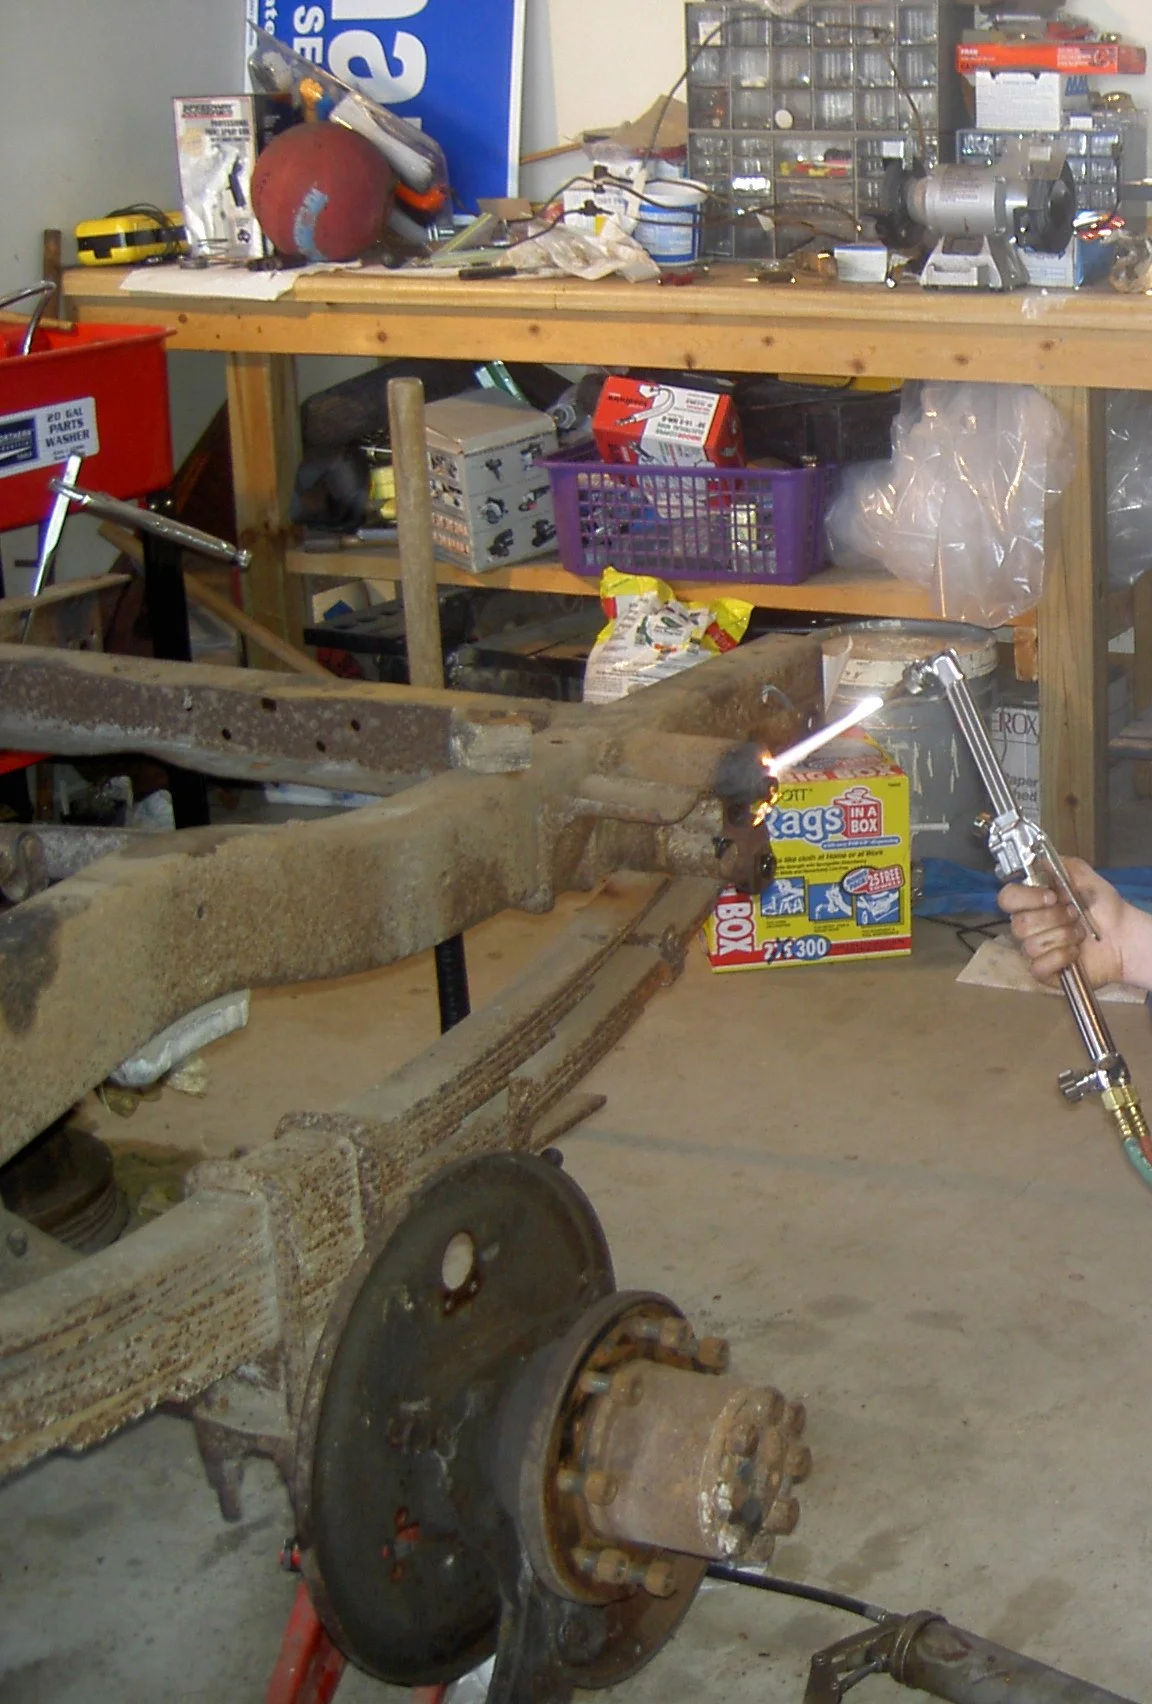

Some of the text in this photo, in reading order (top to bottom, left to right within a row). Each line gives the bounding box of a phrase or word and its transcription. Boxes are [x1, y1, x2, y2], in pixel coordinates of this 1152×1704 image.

[47, 411, 62, 422] 20
[49, 418, 84, 434] PARTS
[45, 429, 90, 448] WASHER
[851, 806, 878, 818] IN A
[851, 820, 878, 834] BOX
[868, 874, 880, 886] 25
[880, 868, 901, 883] FREE
[718, 903, 753, 956] BOX
[796, 938, 827, 958] 300
